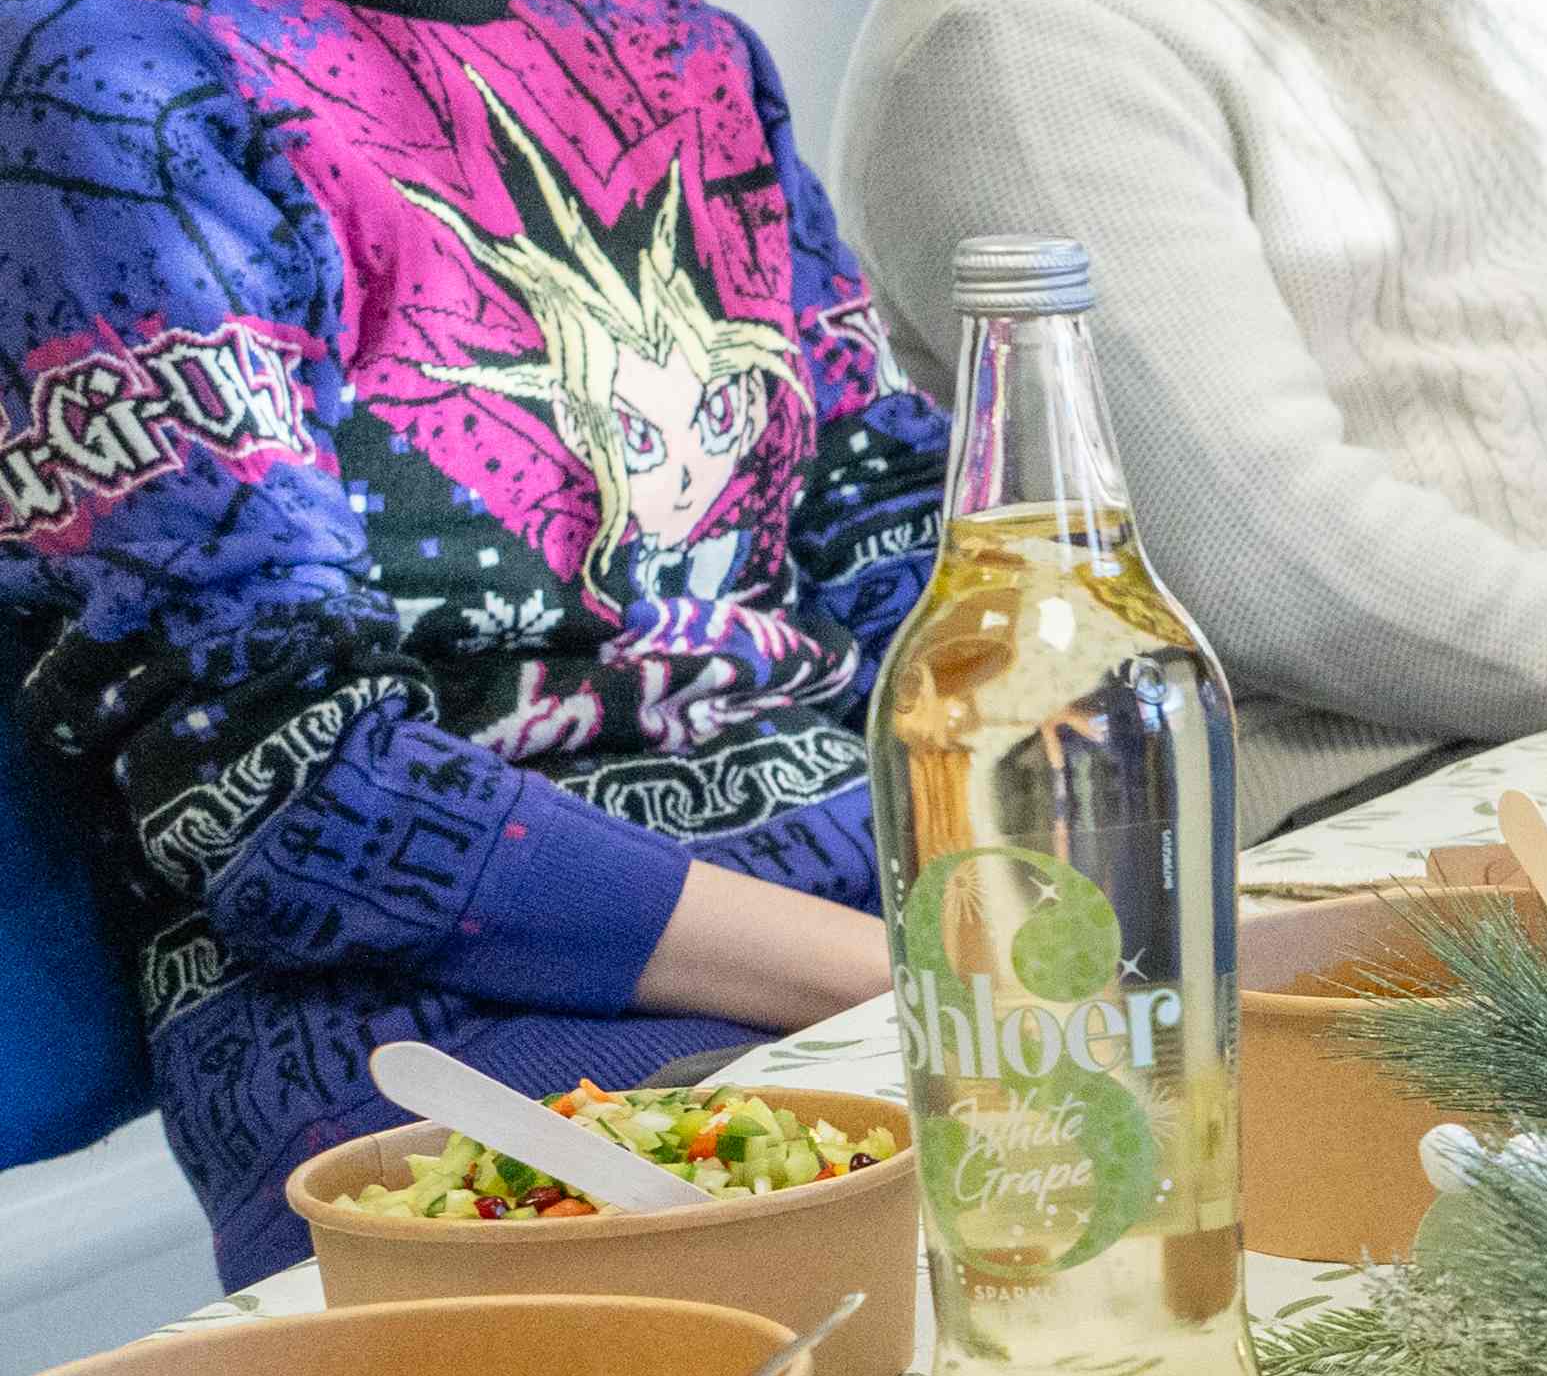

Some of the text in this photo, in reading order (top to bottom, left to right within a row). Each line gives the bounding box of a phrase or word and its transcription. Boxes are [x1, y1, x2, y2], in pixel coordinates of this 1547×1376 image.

[894, 963, 1182, 1080] Shloer
[950, 1087, 1089, 1161] White
[954, 1143, 1095, 1217] Grape
